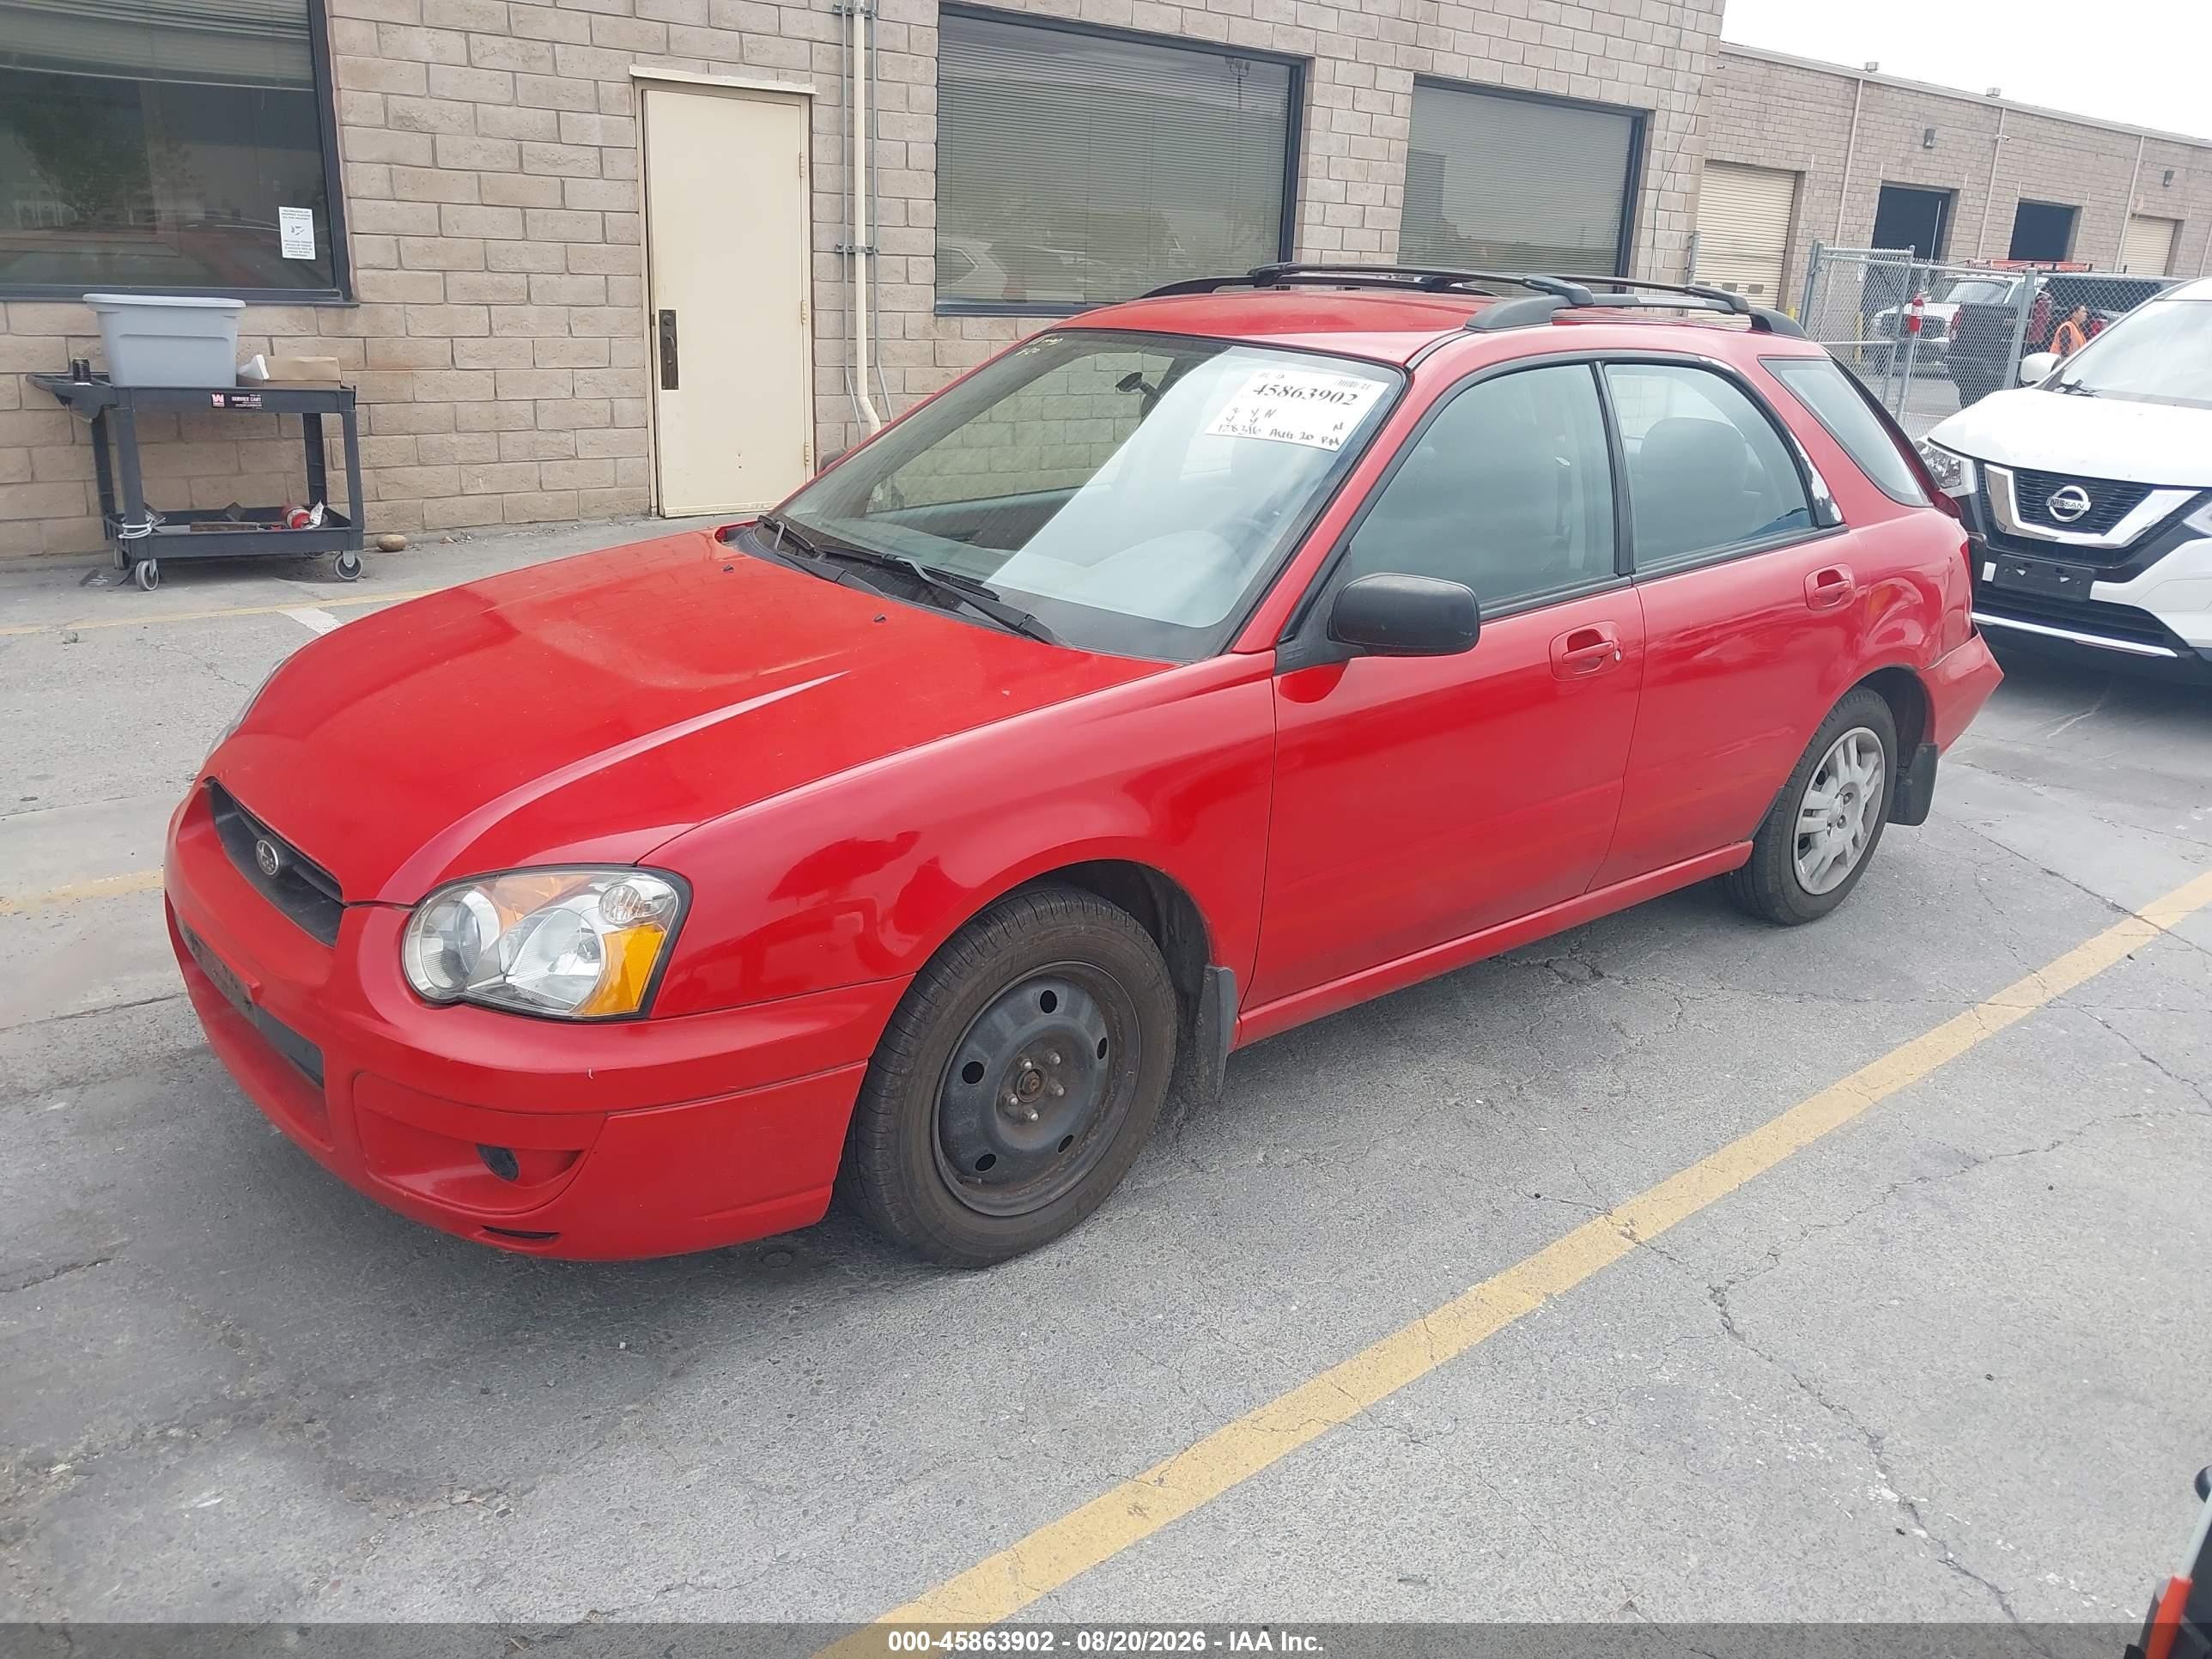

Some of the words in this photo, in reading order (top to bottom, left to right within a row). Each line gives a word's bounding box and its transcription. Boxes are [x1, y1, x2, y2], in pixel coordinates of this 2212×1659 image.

[1253, 384, 1358, 405] 45863902
[1299, 431, 1315, 441] 20
[2051, 498, 2085, 509] NISSAN
